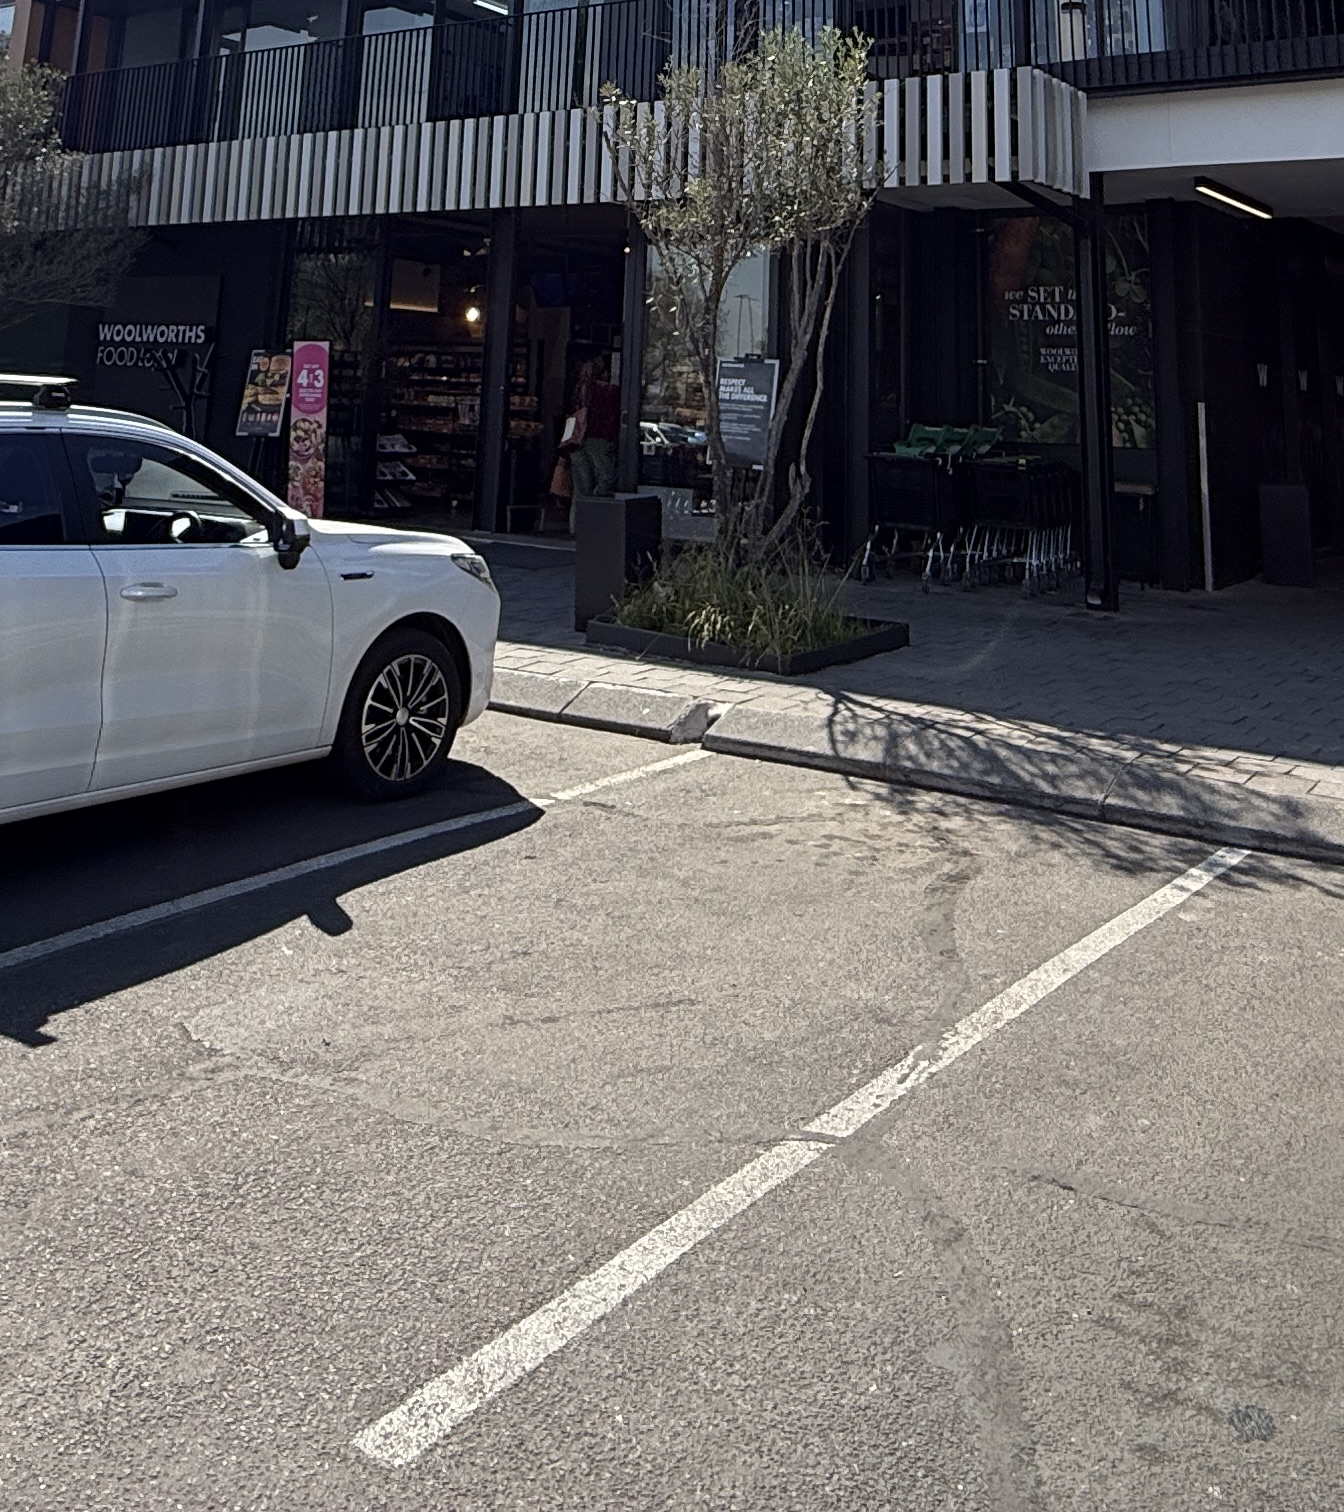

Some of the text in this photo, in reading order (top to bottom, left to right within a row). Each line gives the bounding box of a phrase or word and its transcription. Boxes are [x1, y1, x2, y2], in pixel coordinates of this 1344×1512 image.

[1027, 285, 1064, 303] SET
[98, 323, 206, 344] WOOLWORTHS
[96, 346, 137, 366] FOOD
[297, 369, 309, 387] 4
[314, 369, 325, 388] 3
